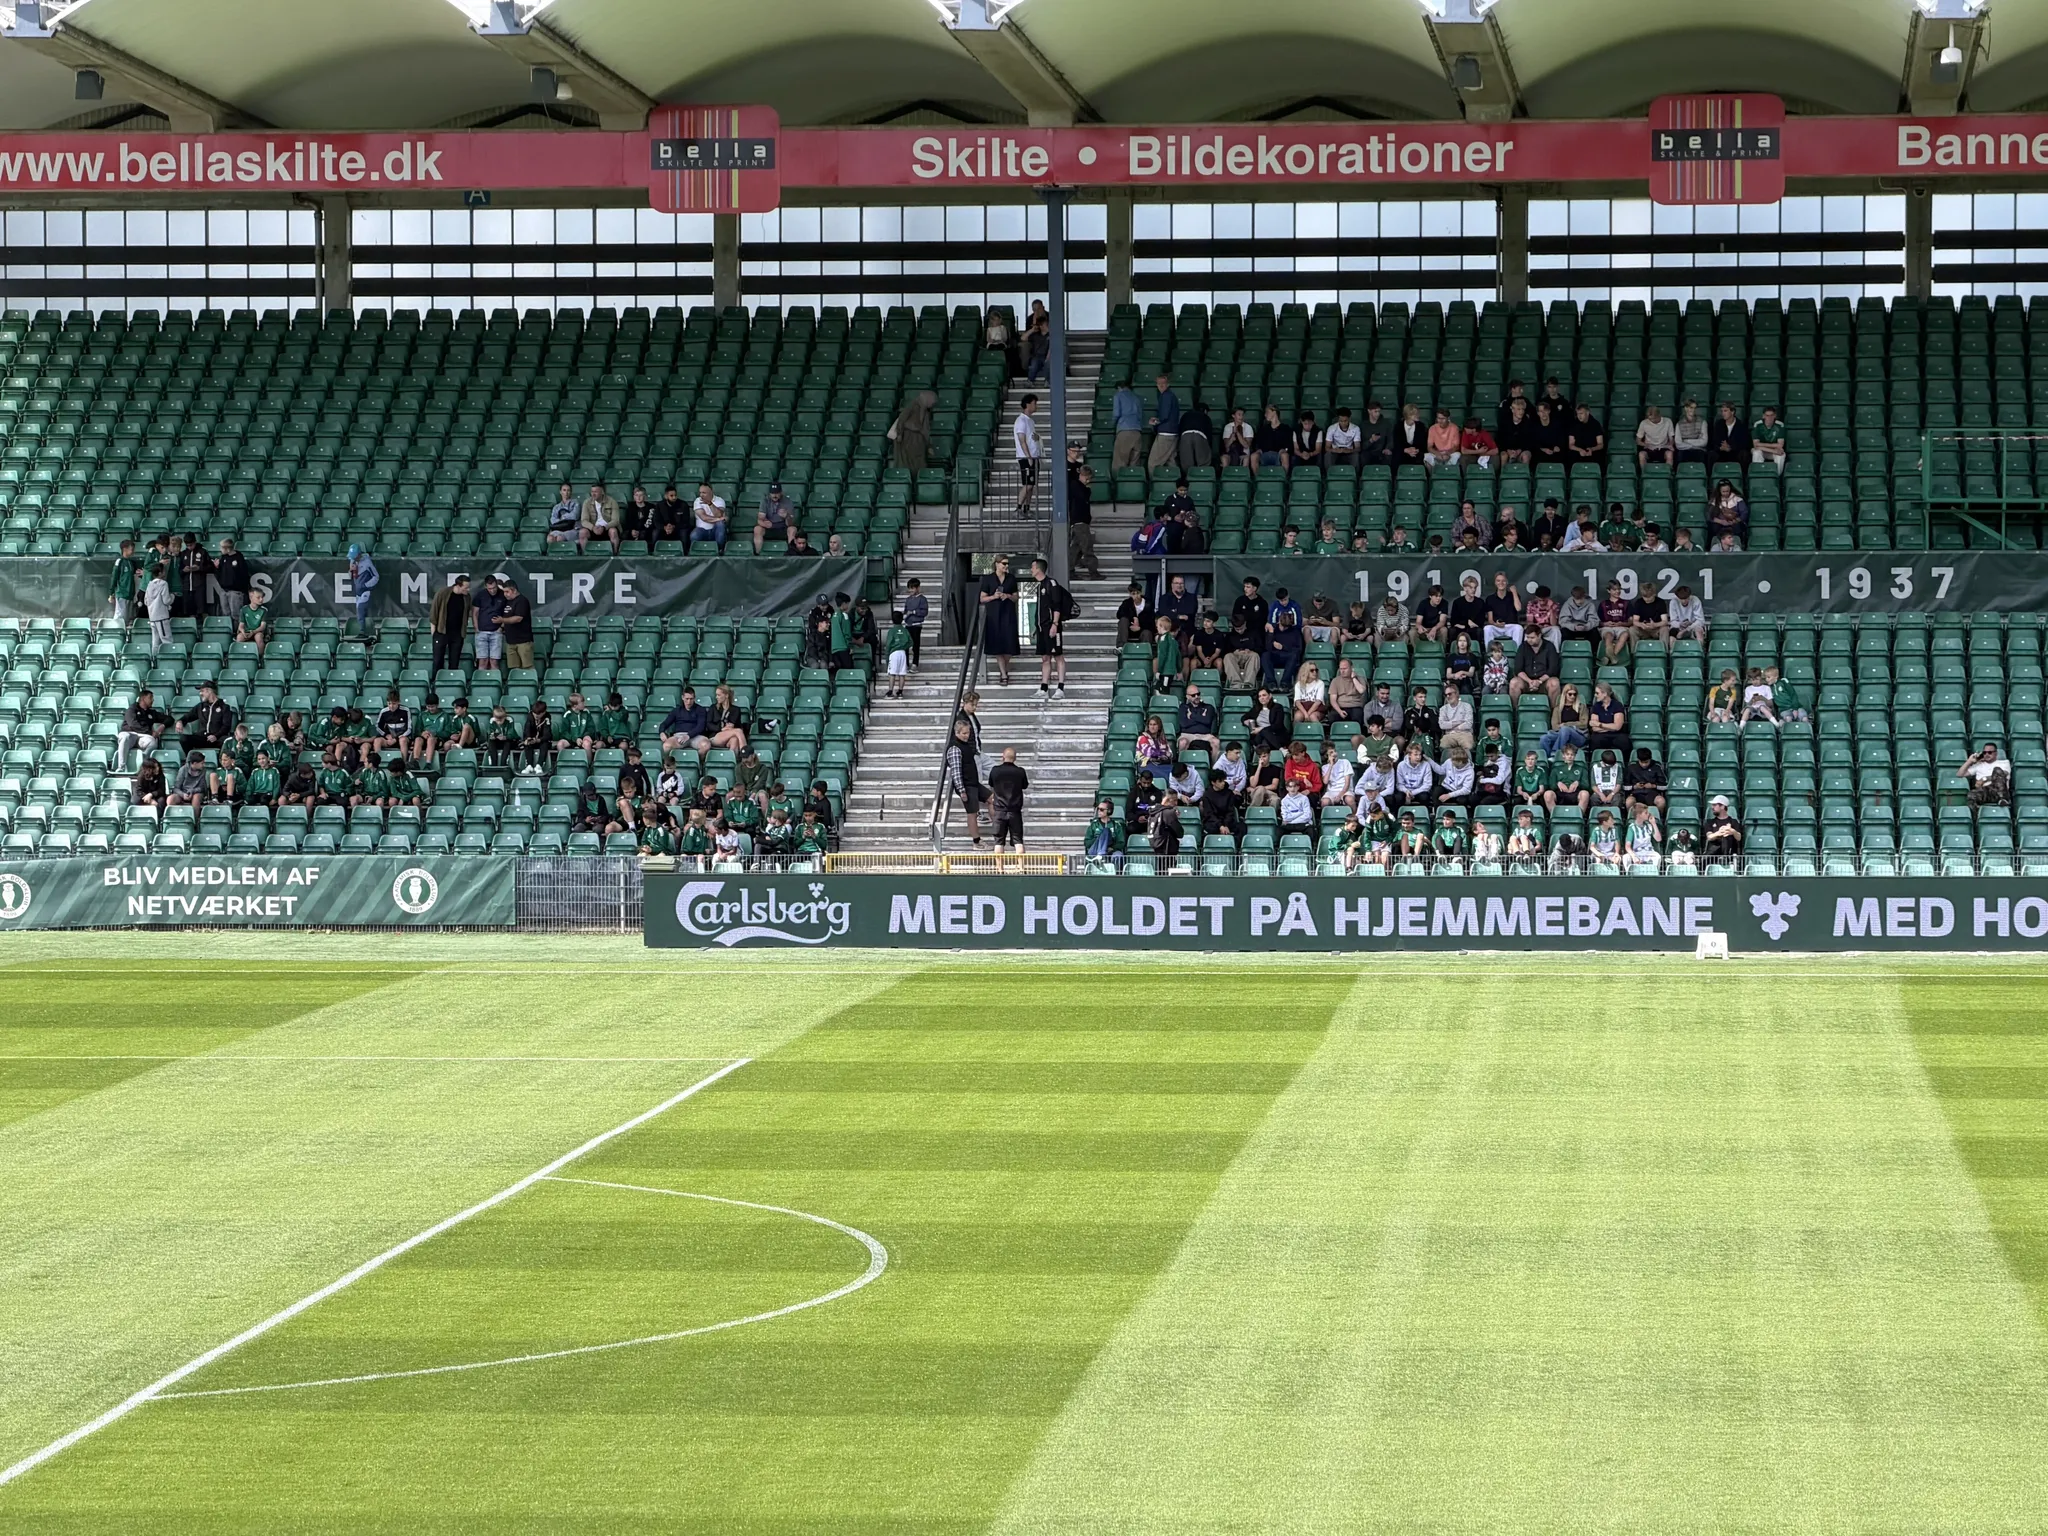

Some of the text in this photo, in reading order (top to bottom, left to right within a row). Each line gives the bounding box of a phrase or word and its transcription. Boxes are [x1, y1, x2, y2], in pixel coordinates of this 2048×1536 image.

[659, 142, 767, 158] bella
[912, 134, 1513, 178] Skilte Bildekorationer
[1660, 132, 1771, 149] bella
[1660, 150, 1705, 158] SKILTE
[1731, 149, 1771, 157] PRINT
[1898, 126, 2048, 166] Banne
[0, 142, 443, 182] www.bellaskilte.dk
[400, 572, 637, 604] MTRE
[1583, 568, 1713, 602] 1921
[1815, 567, 1954, 600] 1937
[103, 866, 320, 886] BLIV MEDLEM AF
[127, 895, 298, 916] NETVÆRKET
[675, 881, 852, 936] Carlsberg
[888, 891, 1714, 937] MED HOLDET PÅ HJEMMEBANE
[1832, 896, 2048, 938] MED HO
